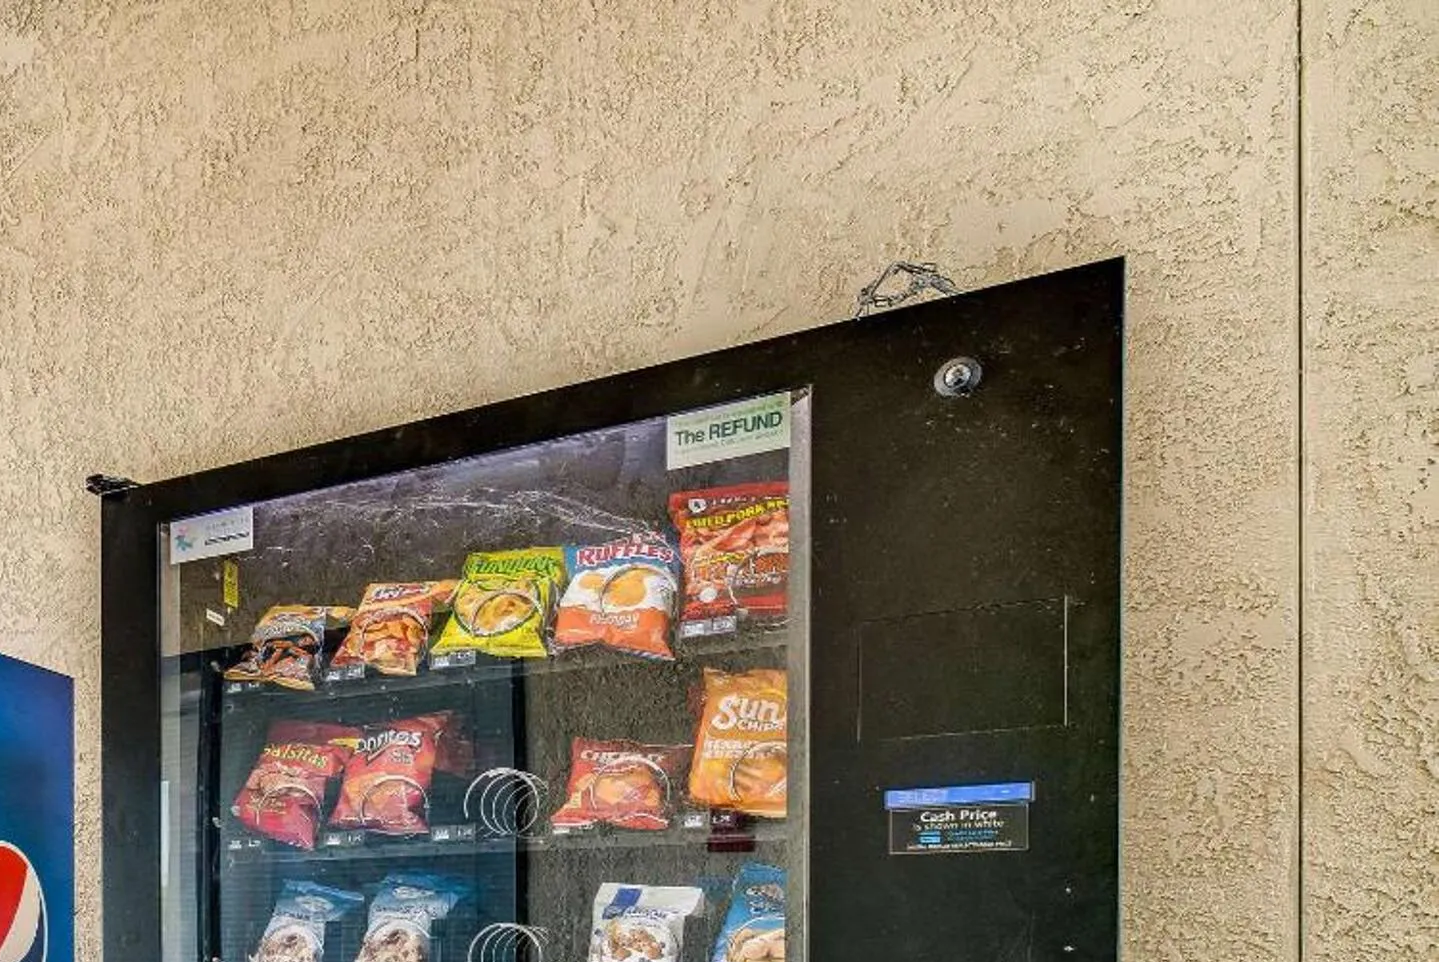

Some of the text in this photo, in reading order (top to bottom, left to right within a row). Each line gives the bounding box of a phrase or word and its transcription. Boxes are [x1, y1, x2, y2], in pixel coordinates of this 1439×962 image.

[675, 429, 705, 446] The
[708, 411, 783, 441] REFUND
[576, 543, 674, 567] RUFFLES
[711, 692, 780, 731] Sun
[354, 729, 424, 755] Doritos
[920, 809, 998, 823] Cash Price
[924, 821, 959, 831] shown
[975, 819, 1005, 829] white
